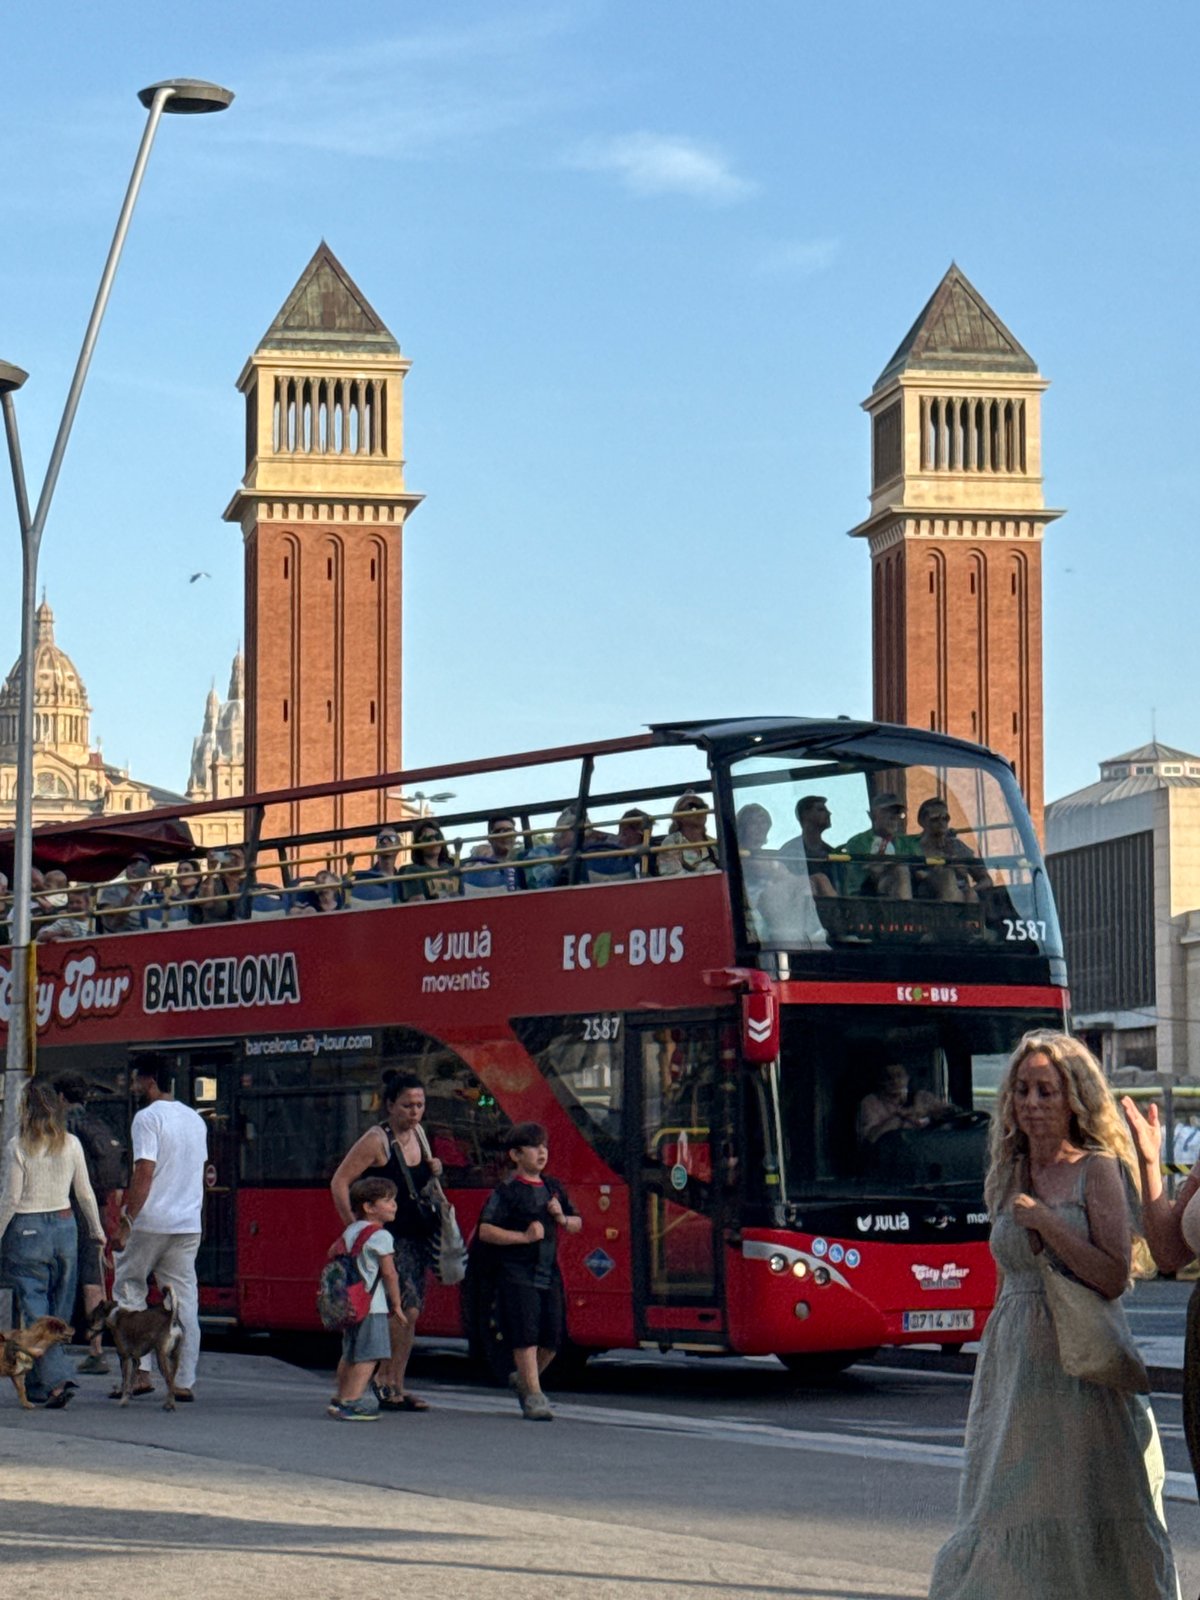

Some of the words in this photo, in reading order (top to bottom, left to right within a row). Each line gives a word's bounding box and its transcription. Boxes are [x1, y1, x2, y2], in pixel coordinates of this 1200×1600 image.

[1003, 919, 1047, 941] 2587
[58, 955, 130, 1020] Tour
[143, 952, 300, 1014] BARCELONA
[421, 966, 491, 993] moventis
[583, 1017, 621, 1040] 2587
[244, 1034, 373, 1056] barcelona.city-tour.com
